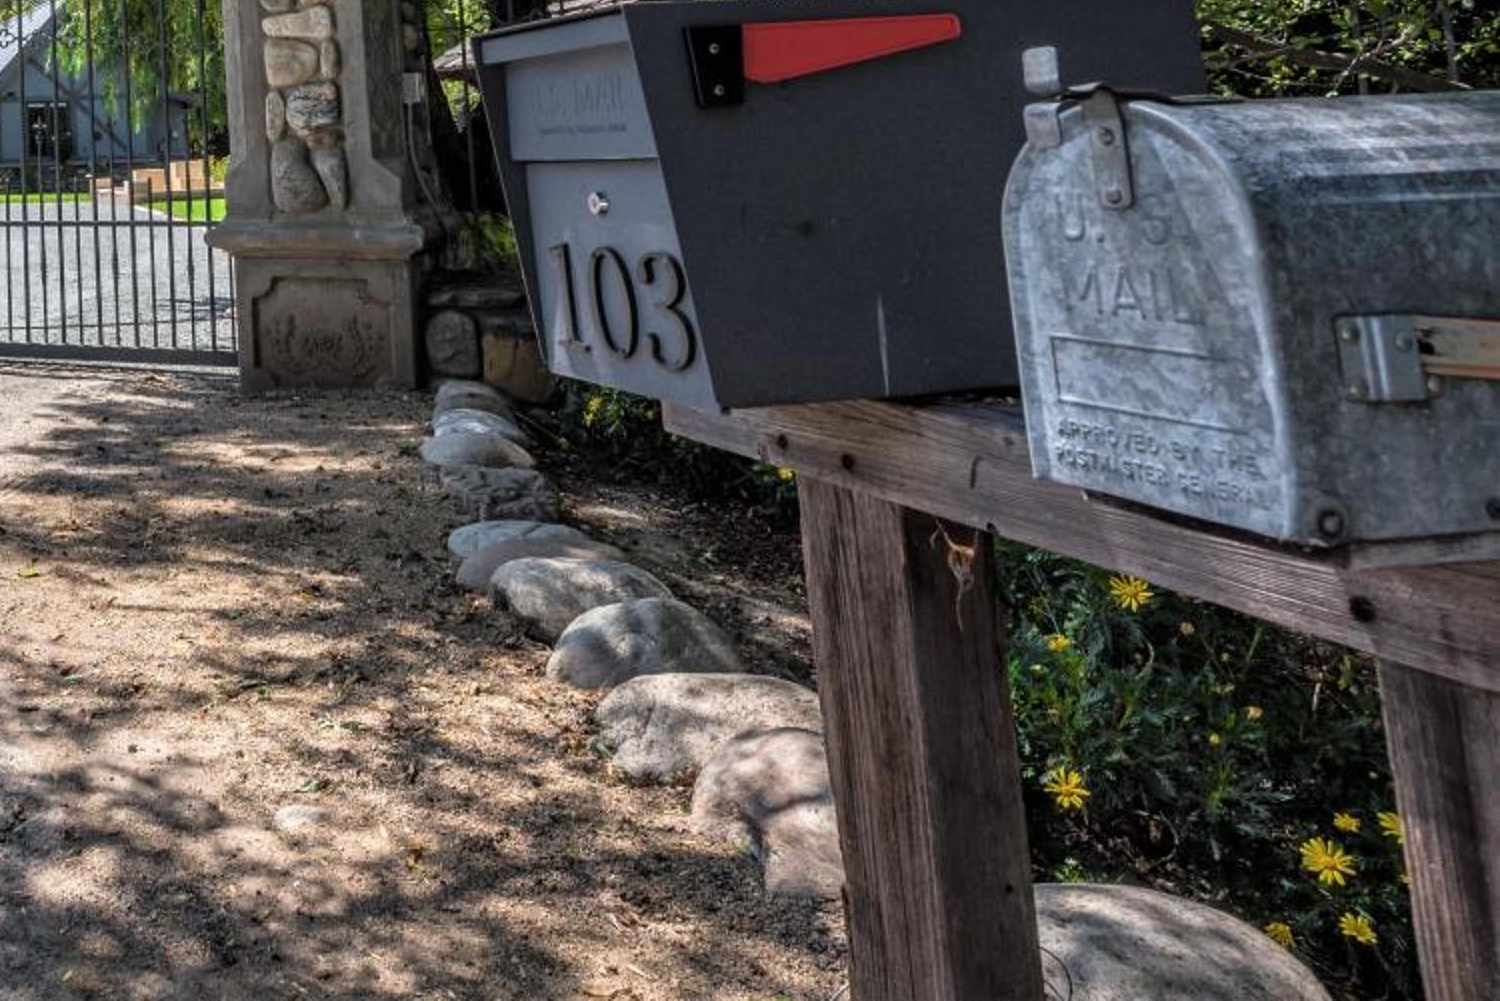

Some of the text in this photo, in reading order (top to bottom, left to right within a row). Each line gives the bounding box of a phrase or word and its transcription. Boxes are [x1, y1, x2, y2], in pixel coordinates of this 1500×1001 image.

[549, 242, 697, 372] 103
[1060, 257, 1207, 328] MAIL
[1056, 442, 1170, 488] POSTMSTER
[1169, 440, 1202, 466] BY
[1211, 446, 1267, 481] THE
